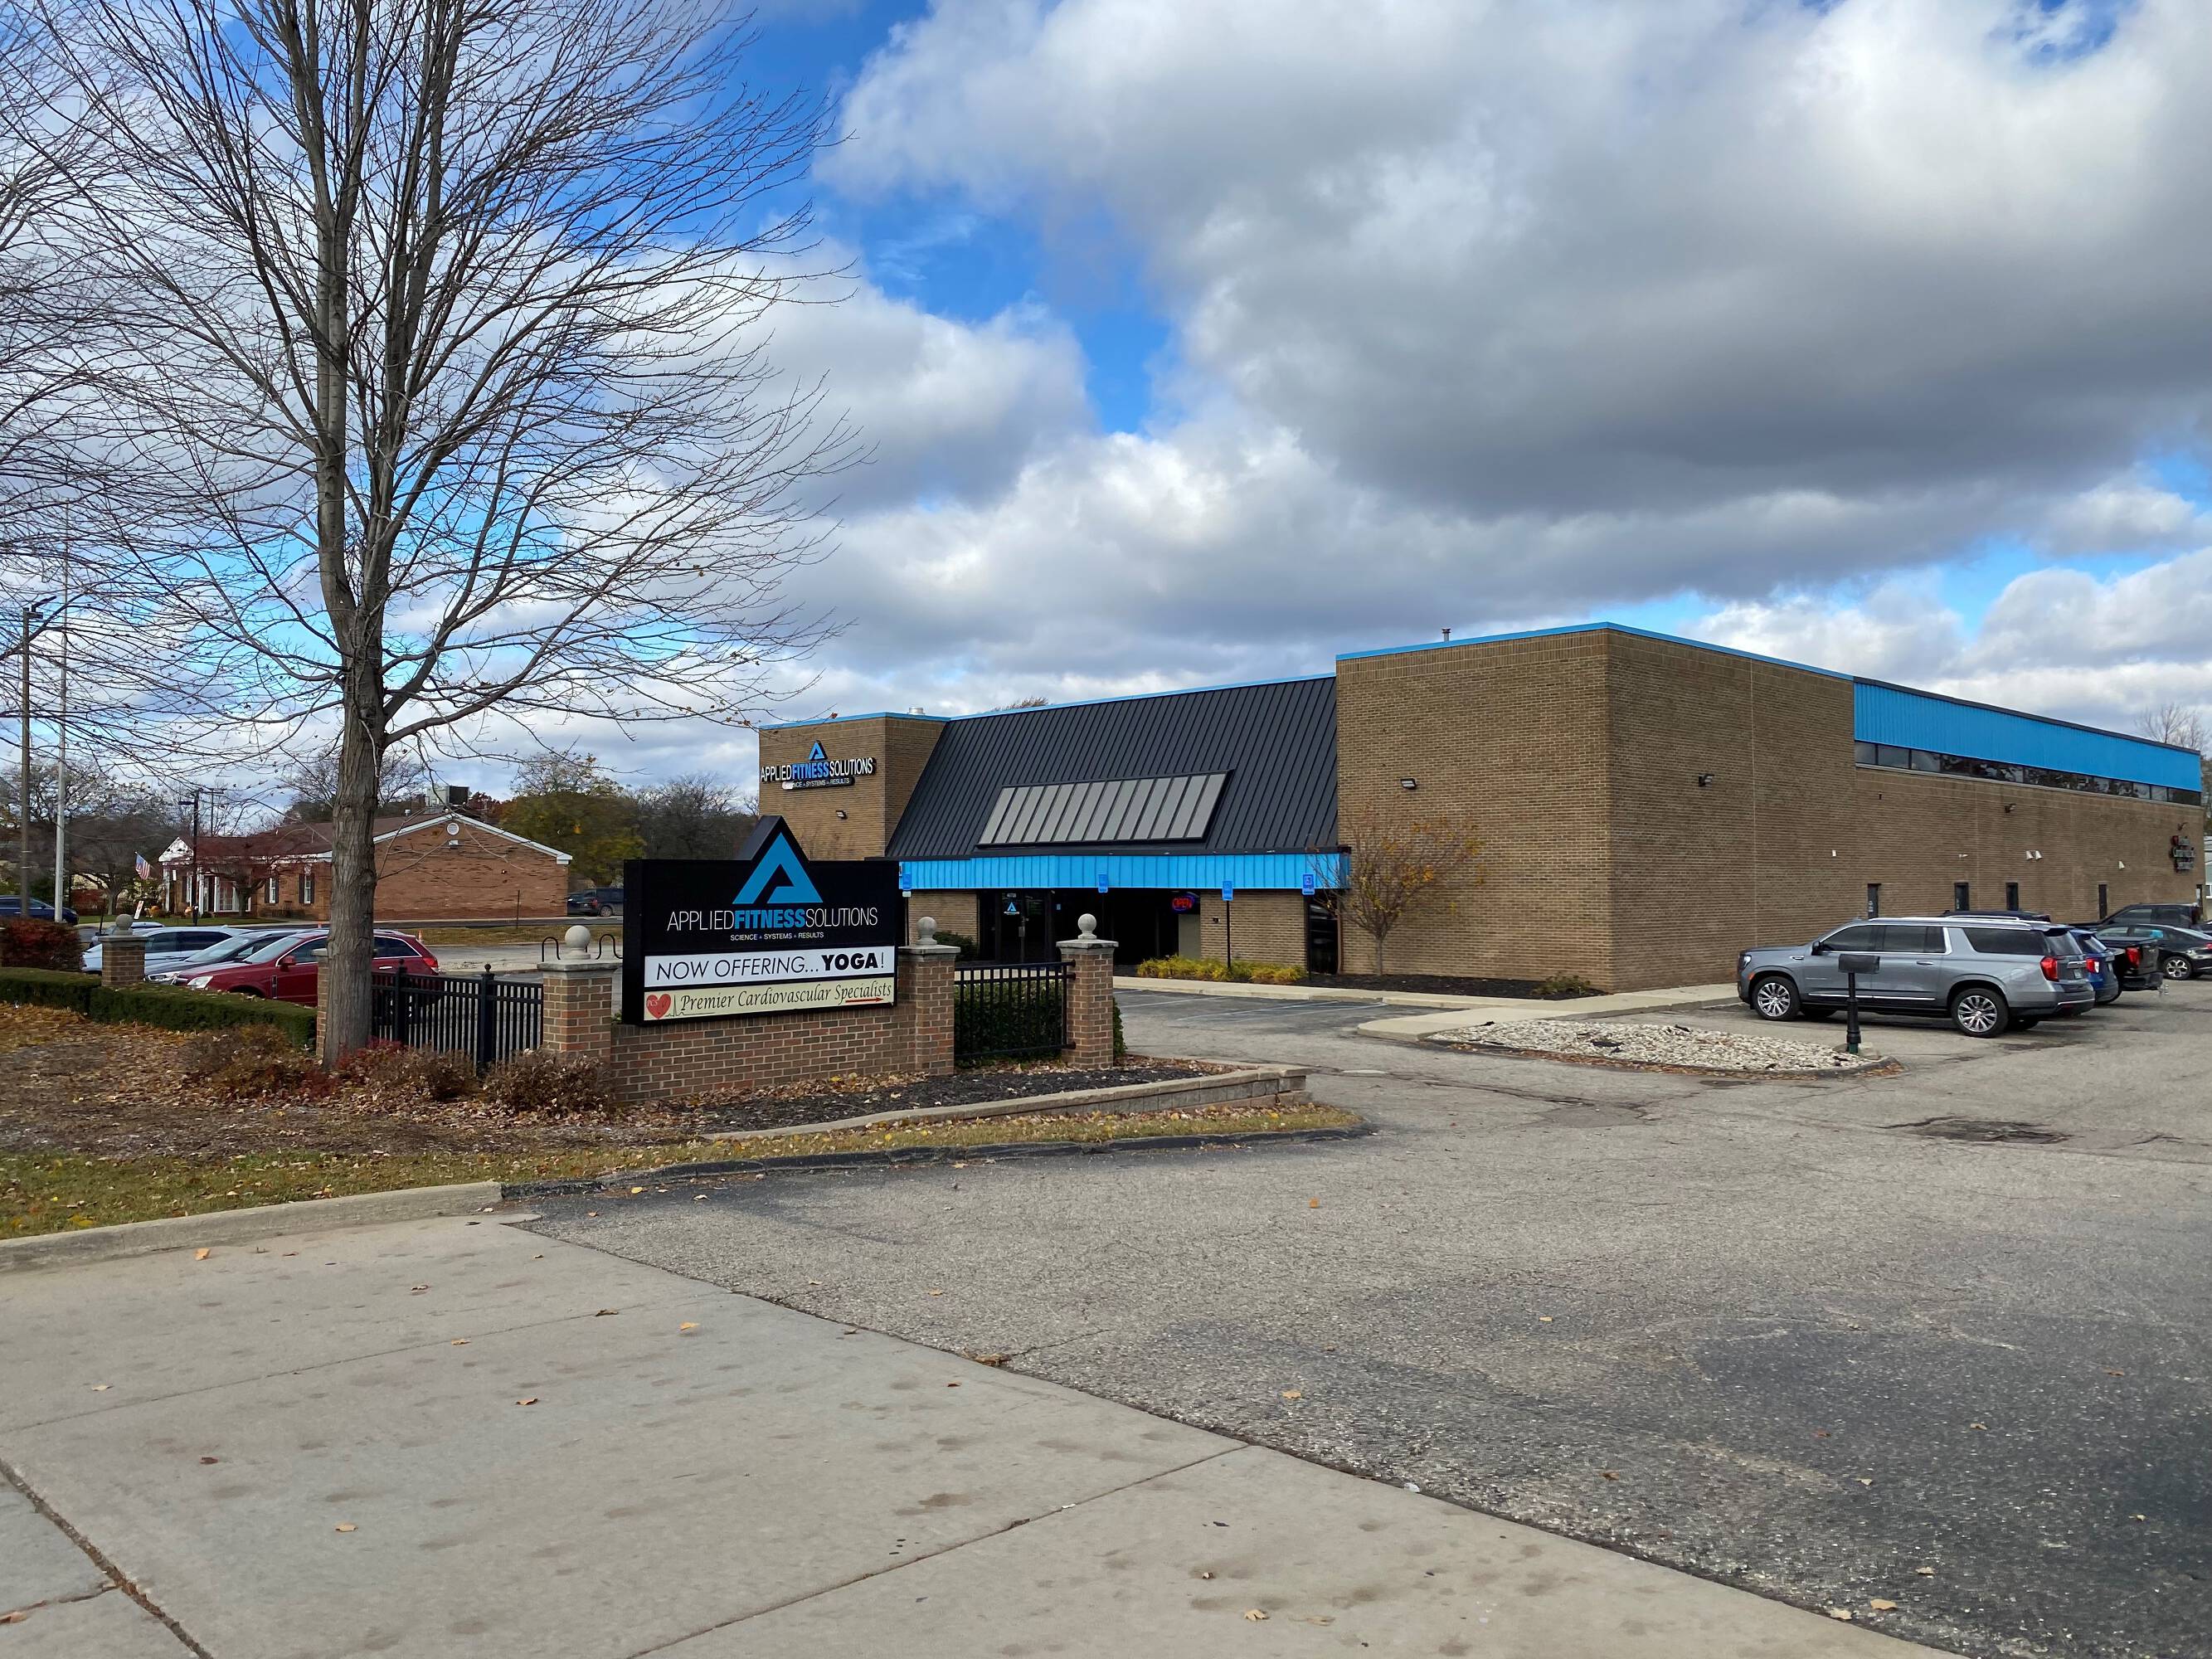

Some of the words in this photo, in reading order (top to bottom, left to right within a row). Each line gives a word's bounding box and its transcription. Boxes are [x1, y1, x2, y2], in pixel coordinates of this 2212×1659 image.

[667, 907, 878, 932] APPLIEDFITNESSSOLUTIONS
[730, 933, 758, 941] SCIENCE
[656, 961, 710, 980] NOW
[821, 951, 884, 971] YOGA!
[680, 992, 735, 1011] Premier
[737, 983, 832, 1007] Cardiovascular
[834, 980, 892, 1005] Specialists
